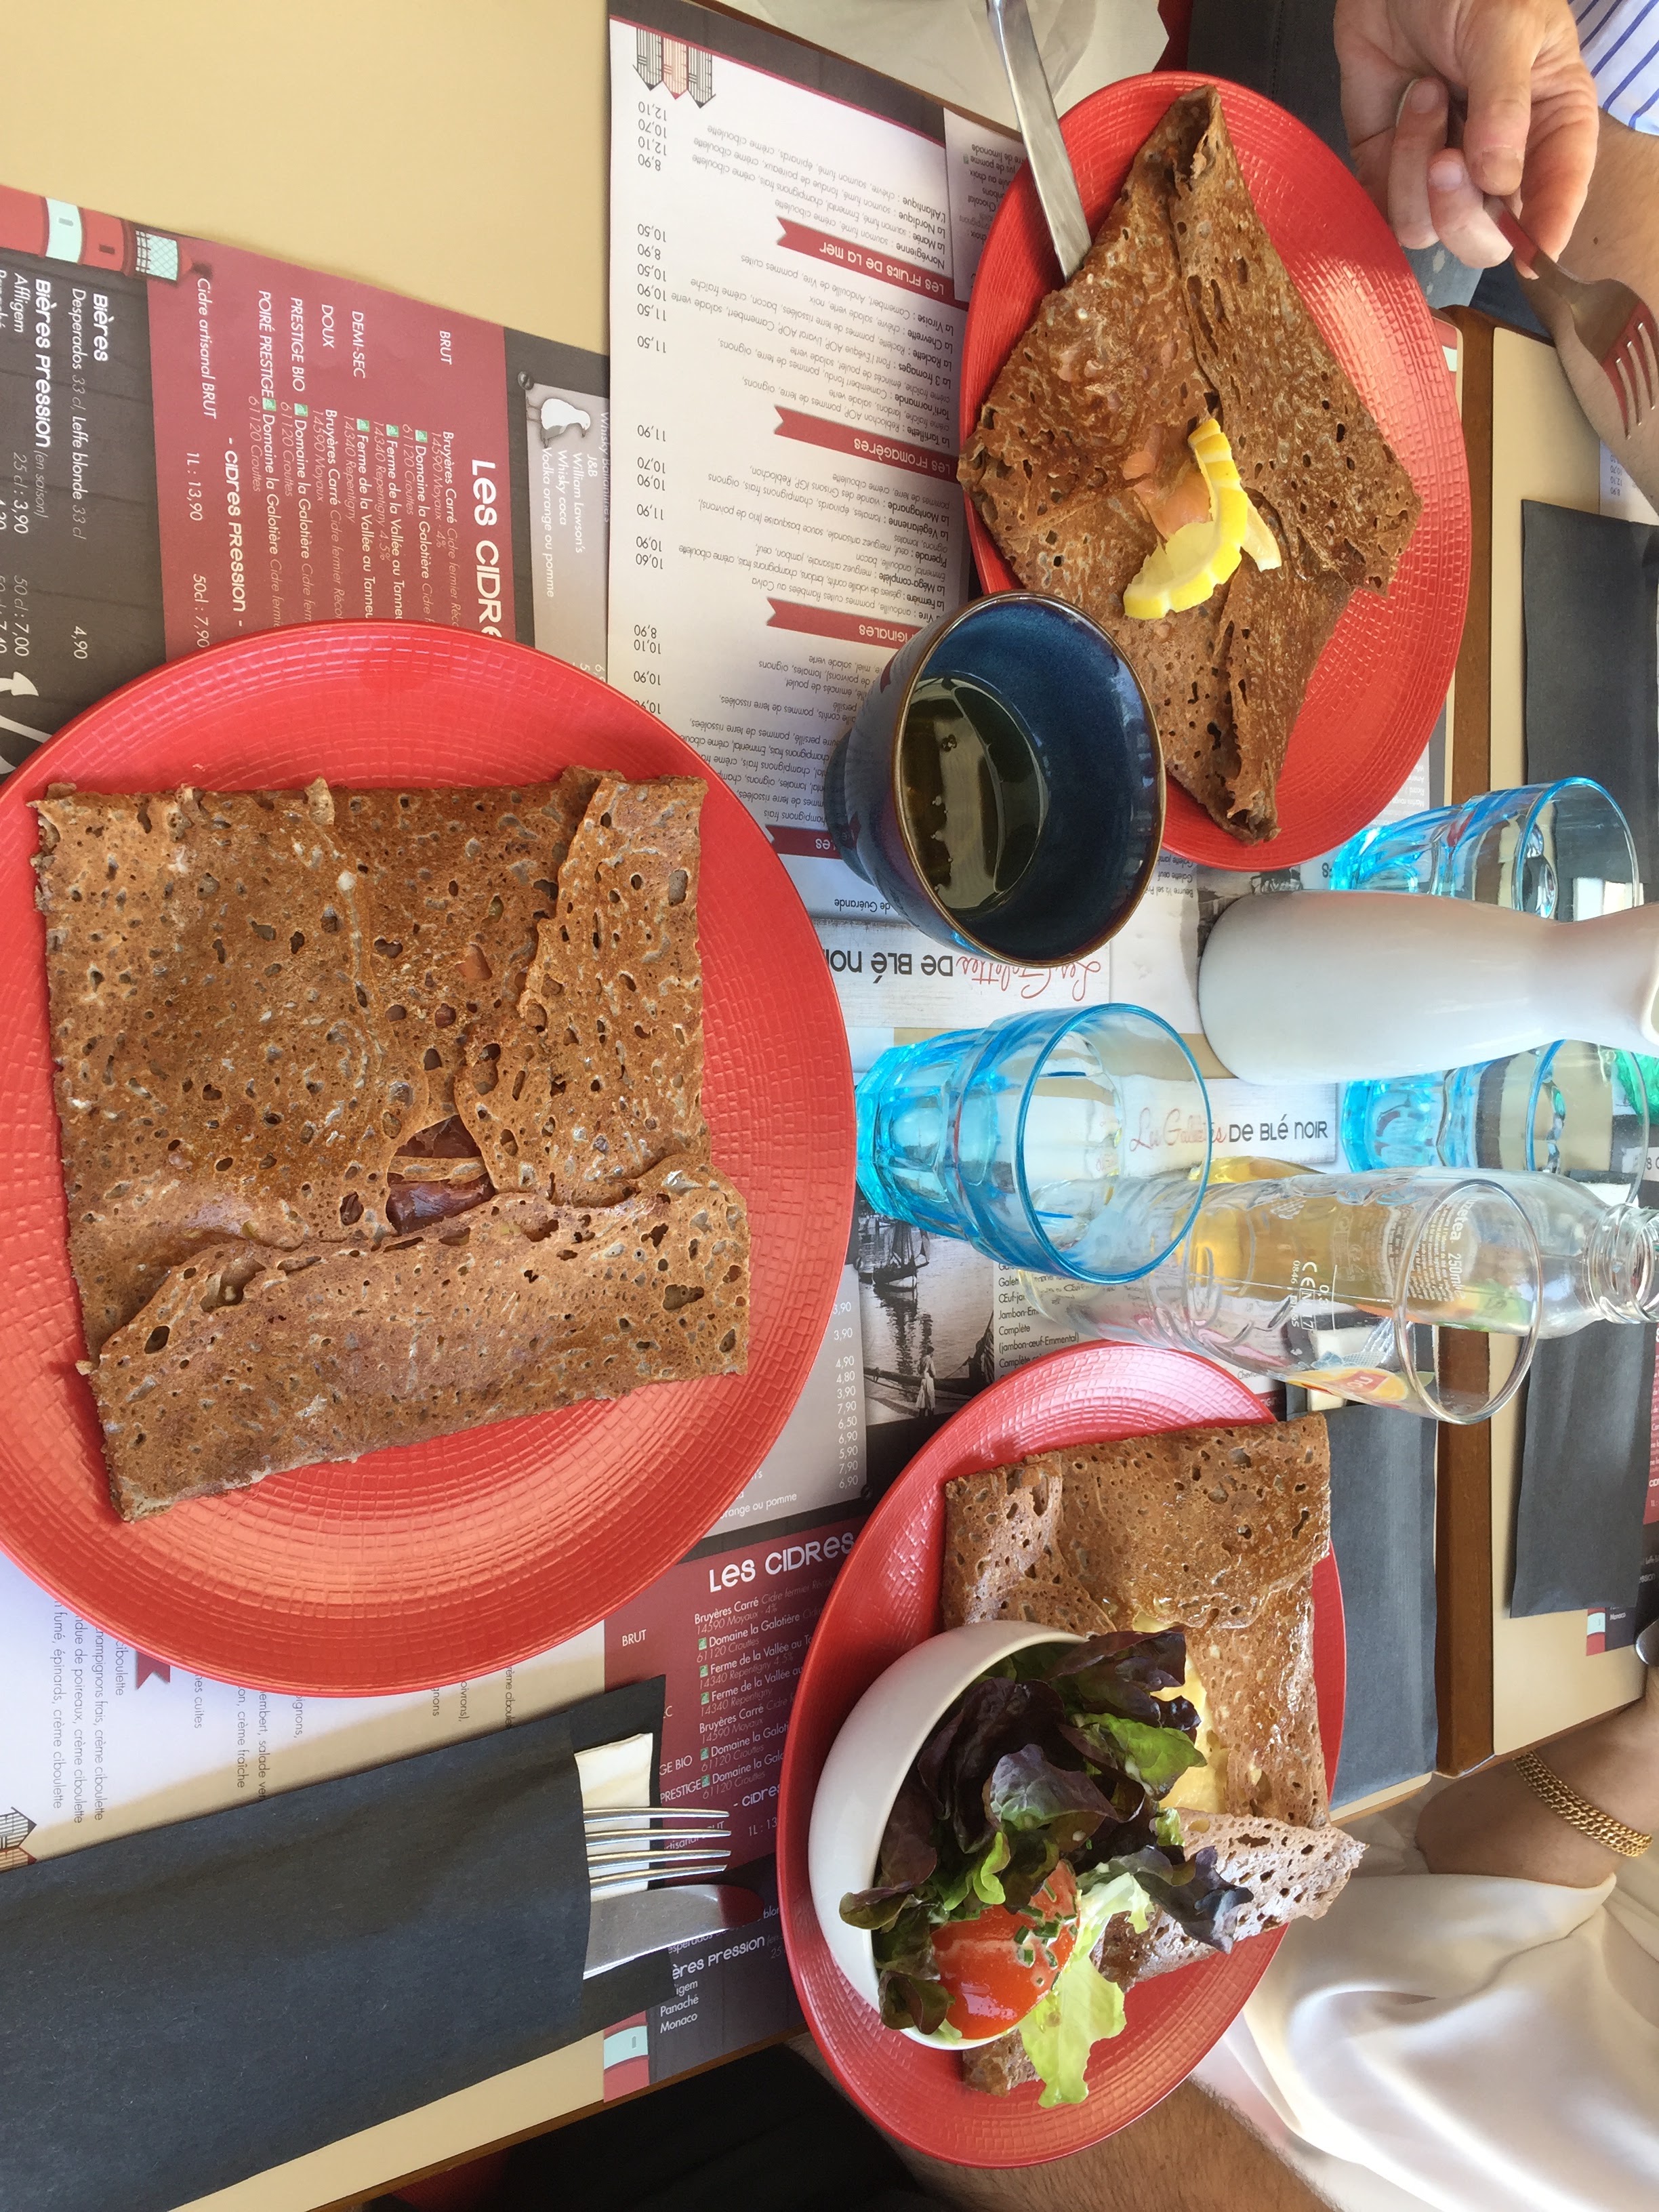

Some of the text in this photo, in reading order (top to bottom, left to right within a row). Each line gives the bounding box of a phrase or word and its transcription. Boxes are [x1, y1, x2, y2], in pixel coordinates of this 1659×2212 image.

[638, 100, 668, 122] 12,10
[638, 118, 667, 139] 10,70
[638, 136, 667, 156] 12,10
[971, 144, 1002, 161] limonade
[638, 153, 661, 171] 8,90
[970, 156, 994, 170] pomme
[902, 197, 946, 223] L'Atlantique
[967, 194, 996, 212] Chocolat
[637, 224, 666, 243] 10,50
[898, 211, 945, 239] La Nordique
[637, 243, 661, 261] 8,90
[912, 232, 945, 254] La Marée
[896, 243, 945, 270] Norvégienne
[636, 263, 666, 282] 10,50
[636, 283, 666, 302] 10,90
[636, 303, 666, 321] 11,50
[321, 304, 335, 348] DOUX
[918, 314, 954, 336] La Viroise
[197, 278, 217, 419] Cidre artisanal BRUT
[258, 290, 276, 399] POIRÉ PRESTIGE
[289, 297, 306, 392] PRESTIGE BIO
[351, 310, 366, 379] DEMI-SEC
[439, 330, 452, 365] BRUT
[636, 335, 666, 354] 11,50
[907, 329, 953, 354] La Chevrette
[912, 349, 952, 371] La Raclette
[898, 363, 951, 390] La 3 fromages
[67, 288, 87, 500] Desperados Leffe blonde
[373, 421, 386, 463] 14340
[637, 424, 665, 442] 11,90
[907, 426, 949, 449] La Tartiflette
[10, 272, 29, 657] Affligem 3,90 7,00
[402, 424, 415, 515] 61120 Crouttes
[586, 453, 598, 478] J&B
[637, 457, 665, 474] 10,70
[186, 451, 203, 521] 1L 13,90
[441, 431, 457, 524] Bruyères Carré
[555, 449, 569, 525] Whisky coca
[637, 474, 665, 491] 10,90
[34, 473, 49, 518] saison)
[373, 464, 387, 527] Repentigny
[386, 440, 403, 557] Ferme de la Vallée
[431, 431, 446, 548] 14590 Moyaux 4%
[415, 445, 432, 579] Domaine la Galotière
[571, 452, 586, 554] William Lawson's
[636, 504, 664, 520] 11,90
[888, 501, 949, 526] La Montagnarde
[541, 447, 556, 598] Vodka orange ou pomme
[888, 517, 948, 541] La Végétarienne
[636, 536, 662, 552] 10,90
[636, 553, 663, 569] 10,60
[915, 552, 947, 568] Piperade
[752, 577, 775, 591] Calva
[878, 572, 945, 596] La Méga-complète
[192, 573, 210, 649] 50cl 7,90
[906, 594, 945, 611] La Fermière
[918, 611, 933, 623] Vire
[71, 625, 88, 659] 4,90
[634, 624, 657, 638] 8,90
[633, 639, 661, 655] 10,10
[633, 670, 661, 686] 10,90
[834, 897, 878, 914] Guérande
[1290, 1260, 1300, 1284] 0846
[834, 1328, 853, 1340] 3,90
[999, 1323, 1030, 1336] Complète
[835, 1355, 855, 1368] 4,90
[836, 1370, 855, 1384] 4,80
[837, 1401, 857, 1415] 7,90
[838, 1416, 857, 1429] 6,50
[838, 1431, 858, 1445] 6,90
[839, 1446, 858, 1460] 5,90
[839, 1476, 858, 1490] 6,90
[753, 1492, 798, 1511] ou pomme
[621, 1629, 647, 1647] BRUT
[50, 1612, 67, 1704] fumé, épinards,
[194, 1697, 205, 1729] cuites
[53, 1709, 66, 1809] crème ciboulette
[93, 1701, 108, 1820] frais, crème ciboulette
[237, 1711, 247, 1788] crème fraîche
[660, 1994, 699, 2018] Panaché
[660, 2012, 698, 2034] Monaco
